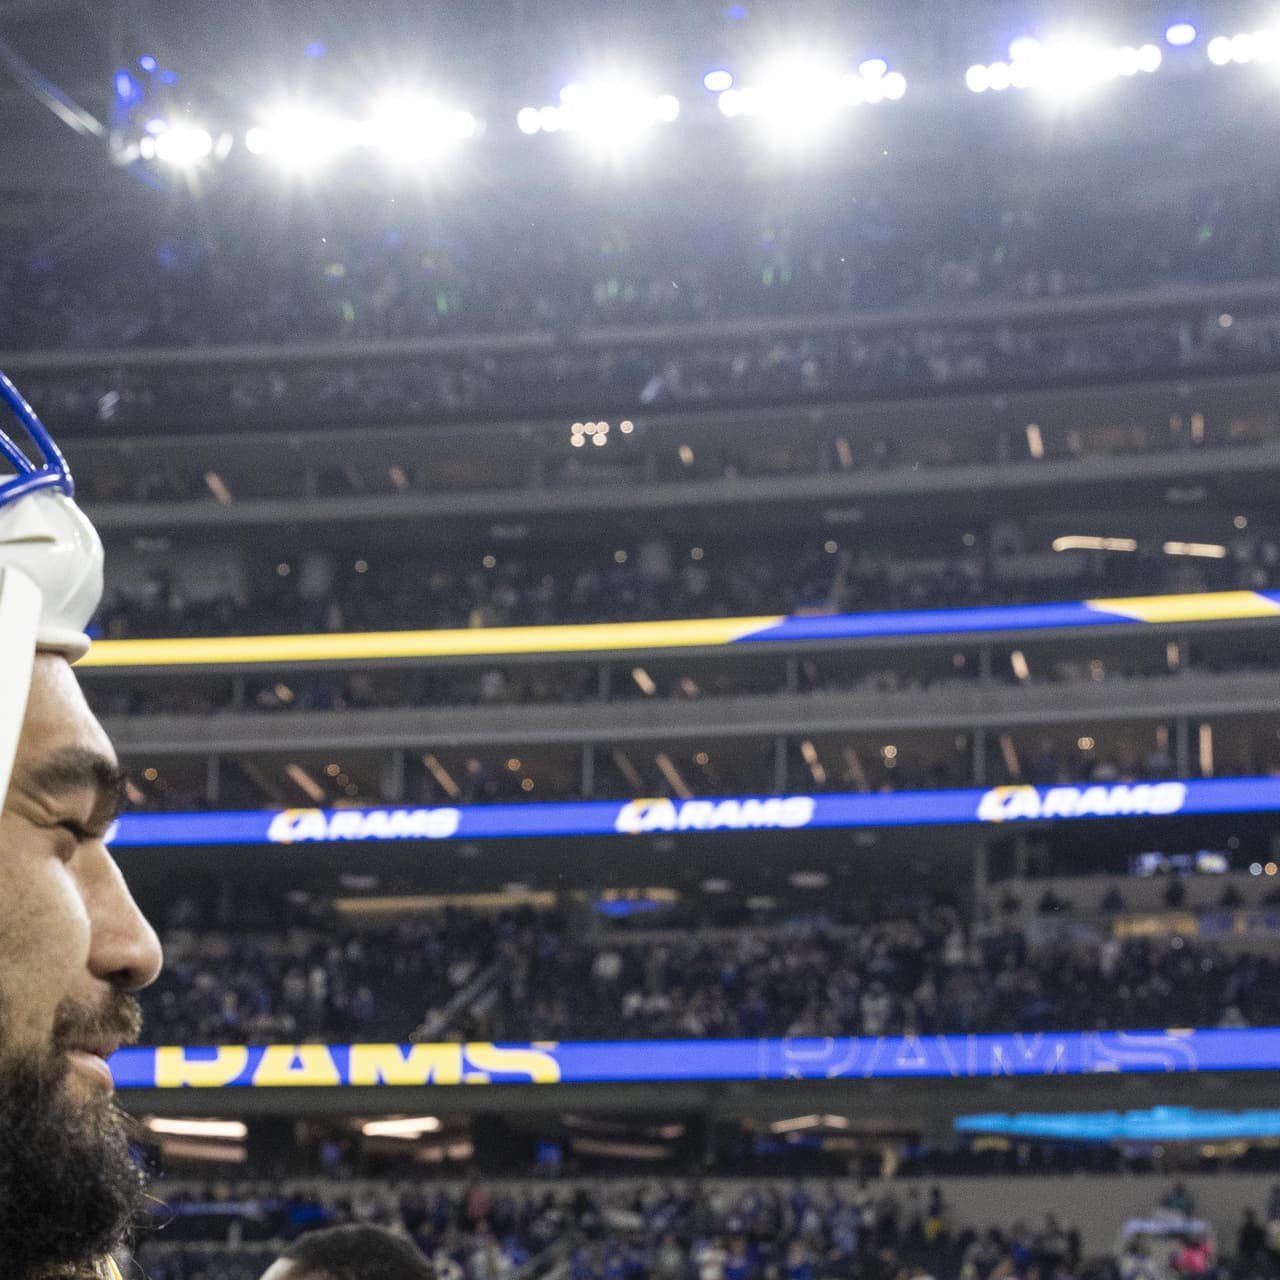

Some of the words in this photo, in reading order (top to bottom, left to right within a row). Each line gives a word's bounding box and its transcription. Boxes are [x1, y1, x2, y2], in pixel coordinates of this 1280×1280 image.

[678, 797, 815, 829] RAMS
[1042, 782, 1188, 817] RAMS
[328, 808, 461, 839] RAMS
